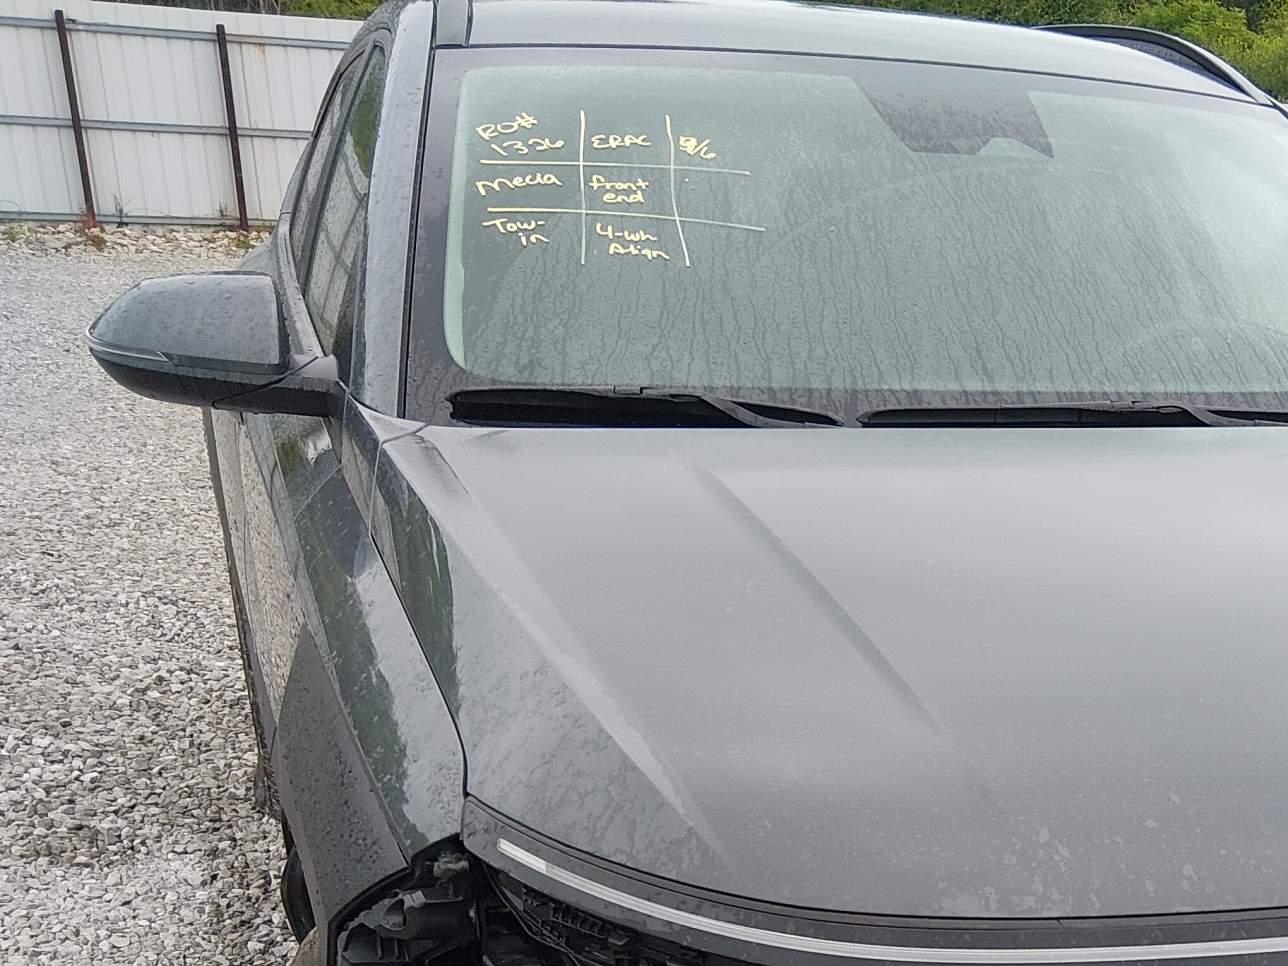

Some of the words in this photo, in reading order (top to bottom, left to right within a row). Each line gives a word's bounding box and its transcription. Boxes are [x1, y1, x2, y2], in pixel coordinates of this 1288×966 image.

[476, 112, 538, 140] RO#
[490, 138, 565, 156] 1326
[602, 190, 645, 203] end
[518, 232, 549, 247] in
